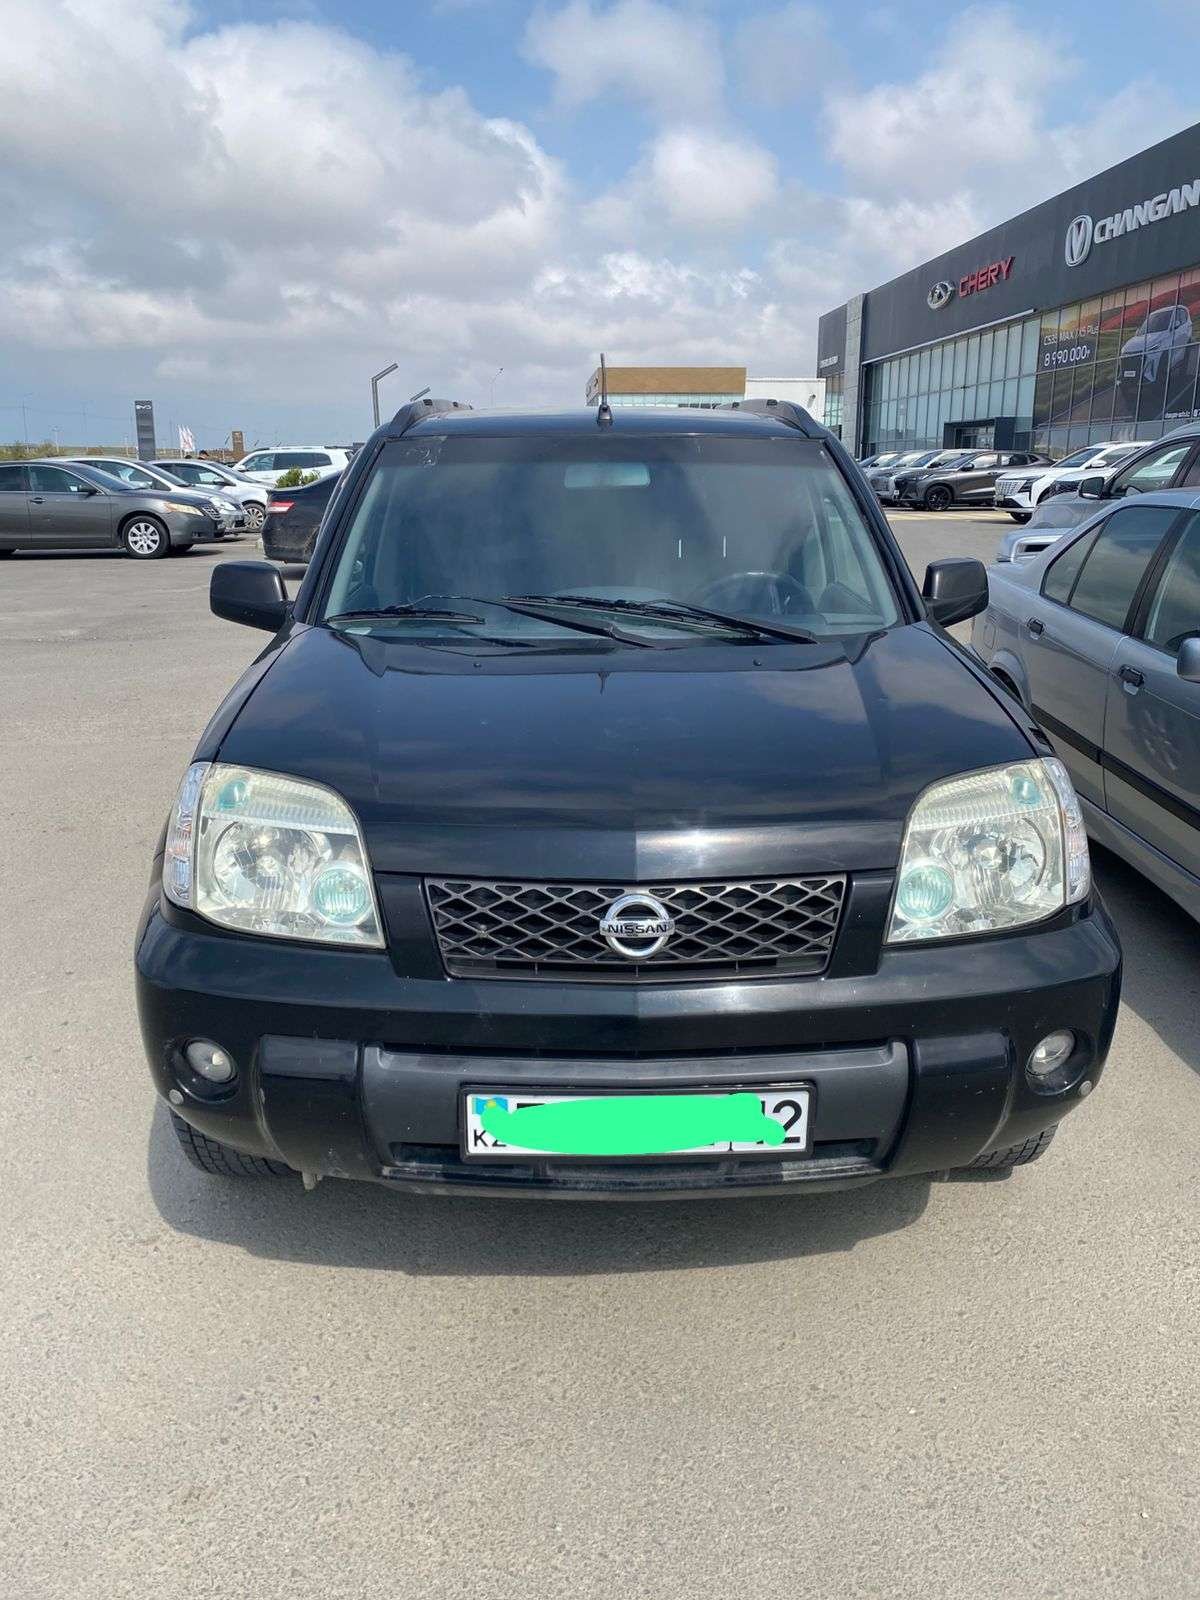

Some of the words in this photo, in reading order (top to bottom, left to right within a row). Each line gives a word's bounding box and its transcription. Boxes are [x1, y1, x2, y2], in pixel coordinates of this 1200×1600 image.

[1094, 179, 1200, 244] CHANGAN
[959, 255, 1016, 298] CHERY
[1044, 352, 1051, 367] 8
[607, 923, 668, 934] NISSAN
